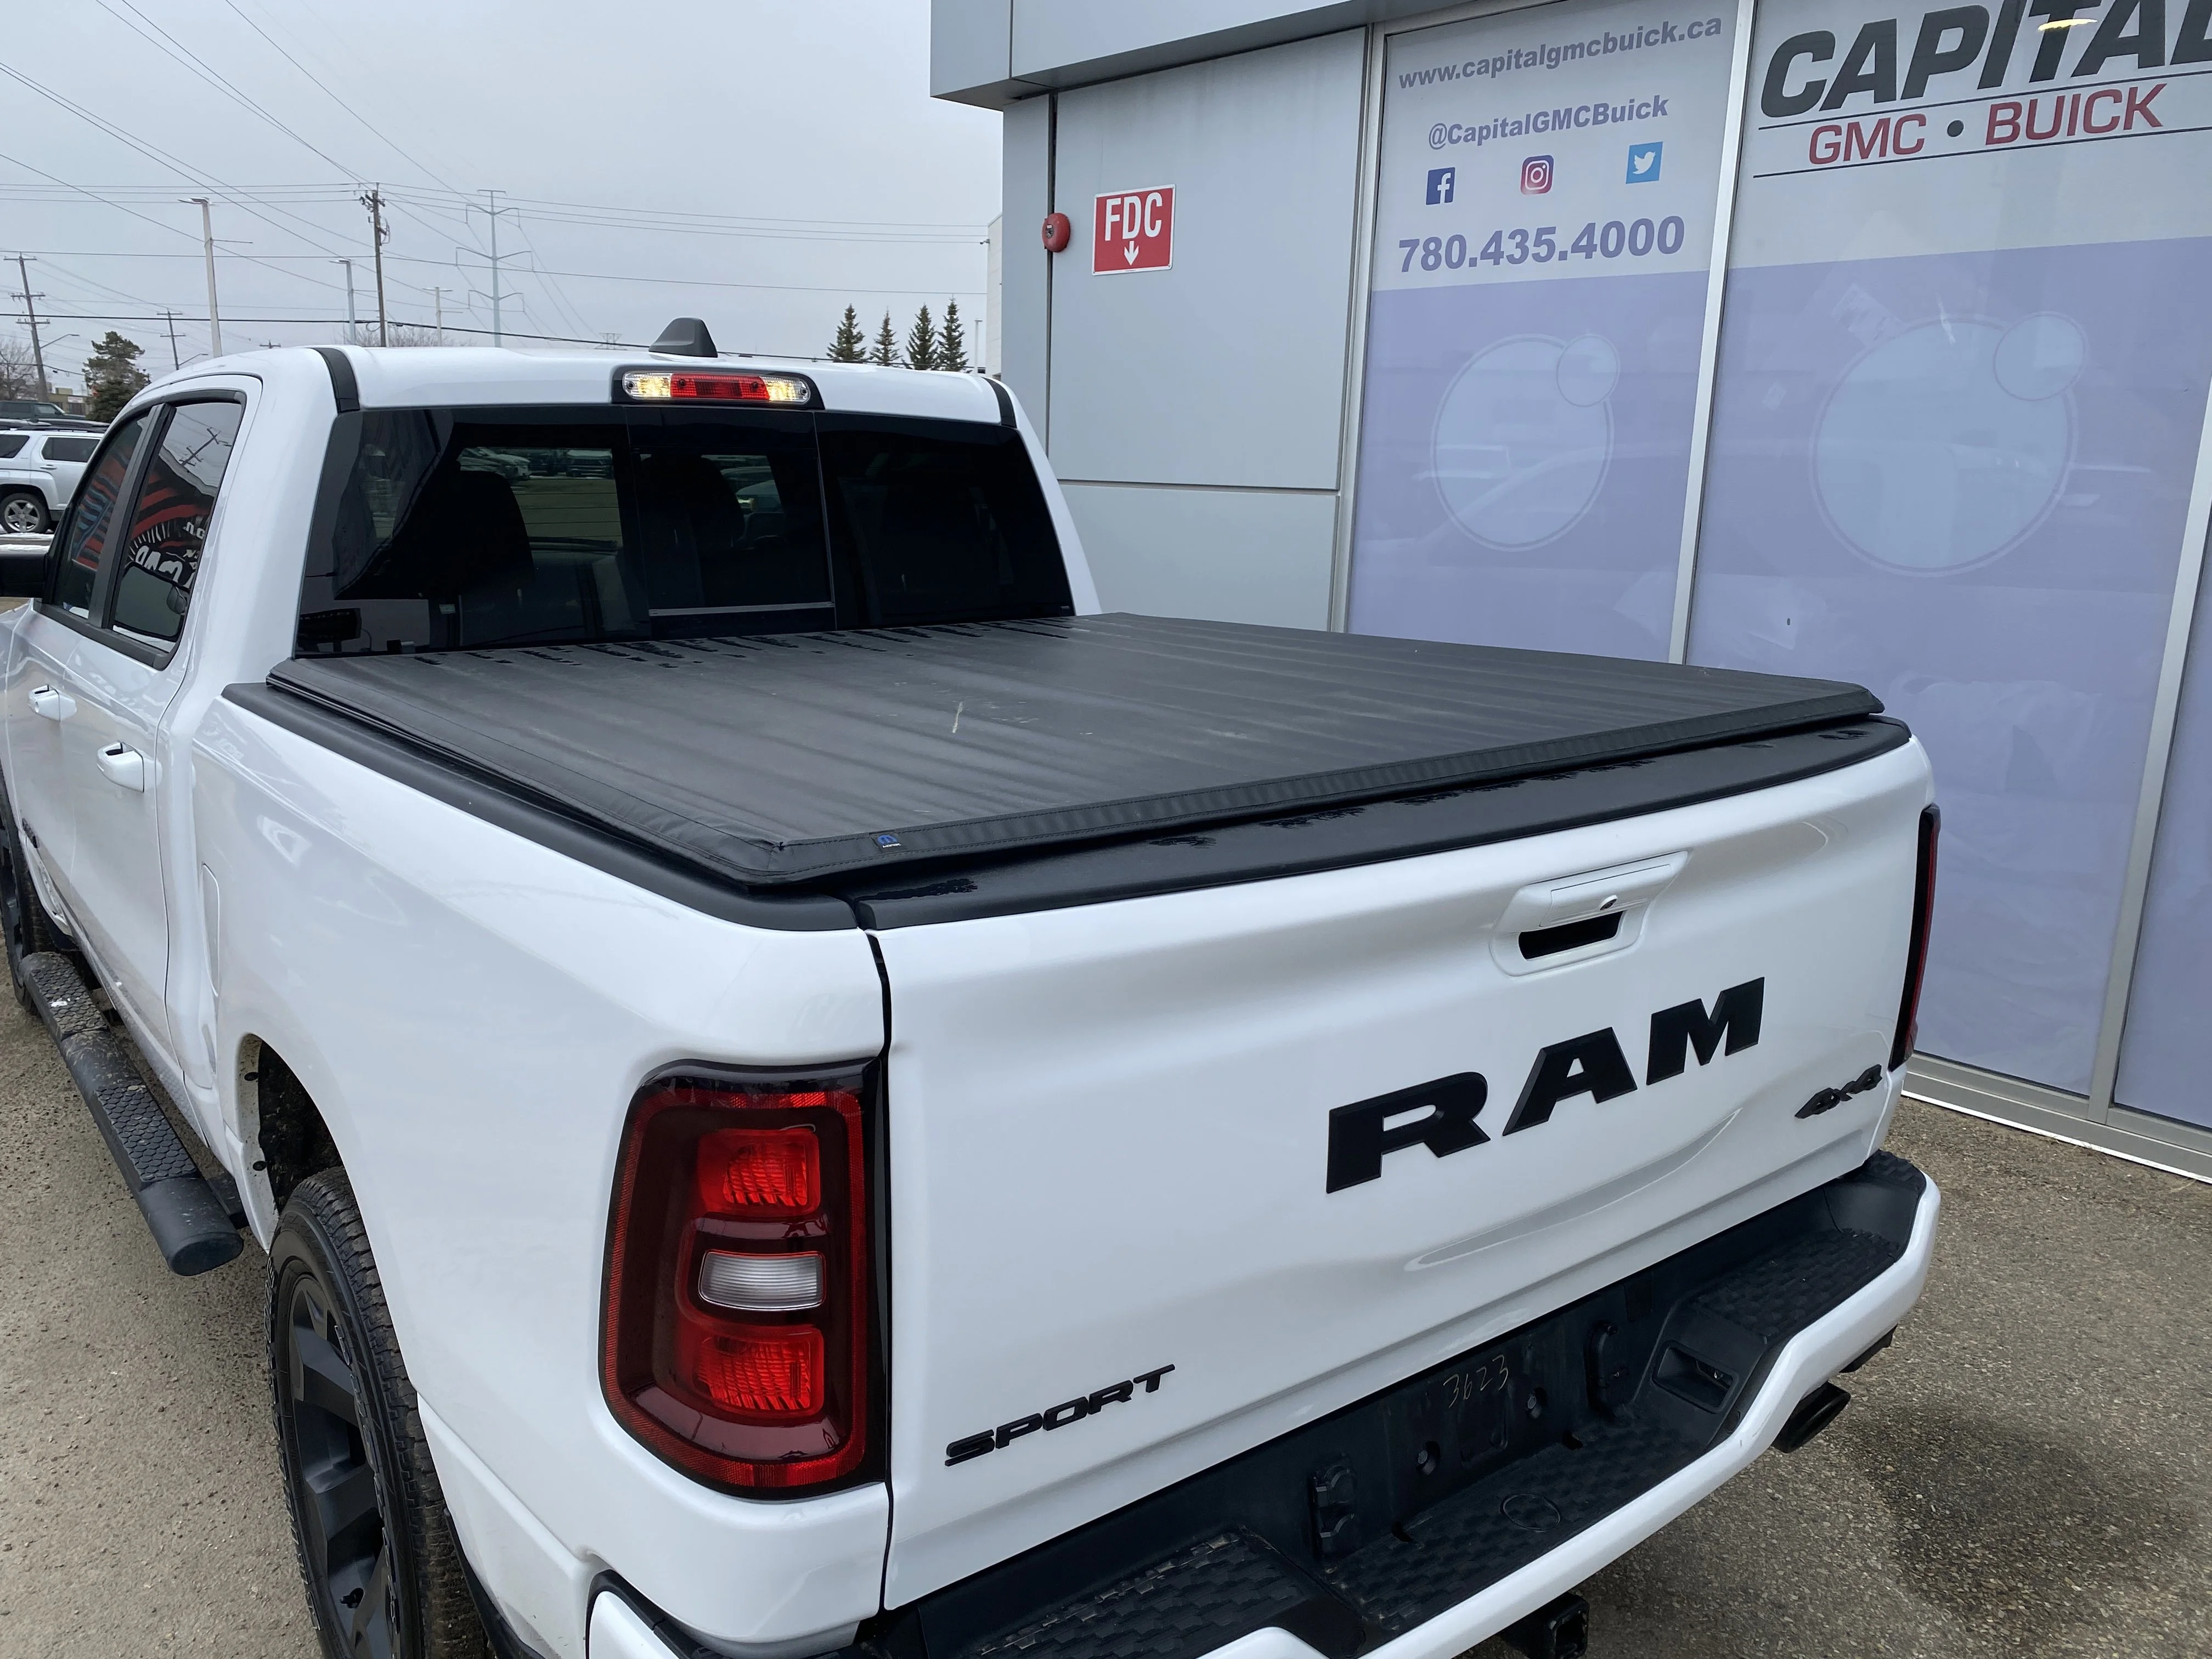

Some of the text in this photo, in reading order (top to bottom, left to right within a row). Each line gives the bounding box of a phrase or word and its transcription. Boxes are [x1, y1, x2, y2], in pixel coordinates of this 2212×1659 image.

[1399, 18, 1722, 89] www.capitalgmcbuick.ca
[1760, 0, 2212, 118] CAPITAL
[1429, 95, 1669, 150] @CapitalGMCBuick
[1809, 83, 2167, 165] GMC BUICK
[1105, 192, 1163, 241] FDC
[1398, 216, 1685, 273] 780.435.4000
[1326, 977, 1765, 1194] RAM
[944, 1363, 1176, 1468] SPORT
[1443, 1354, 1509, 1409] 3623
